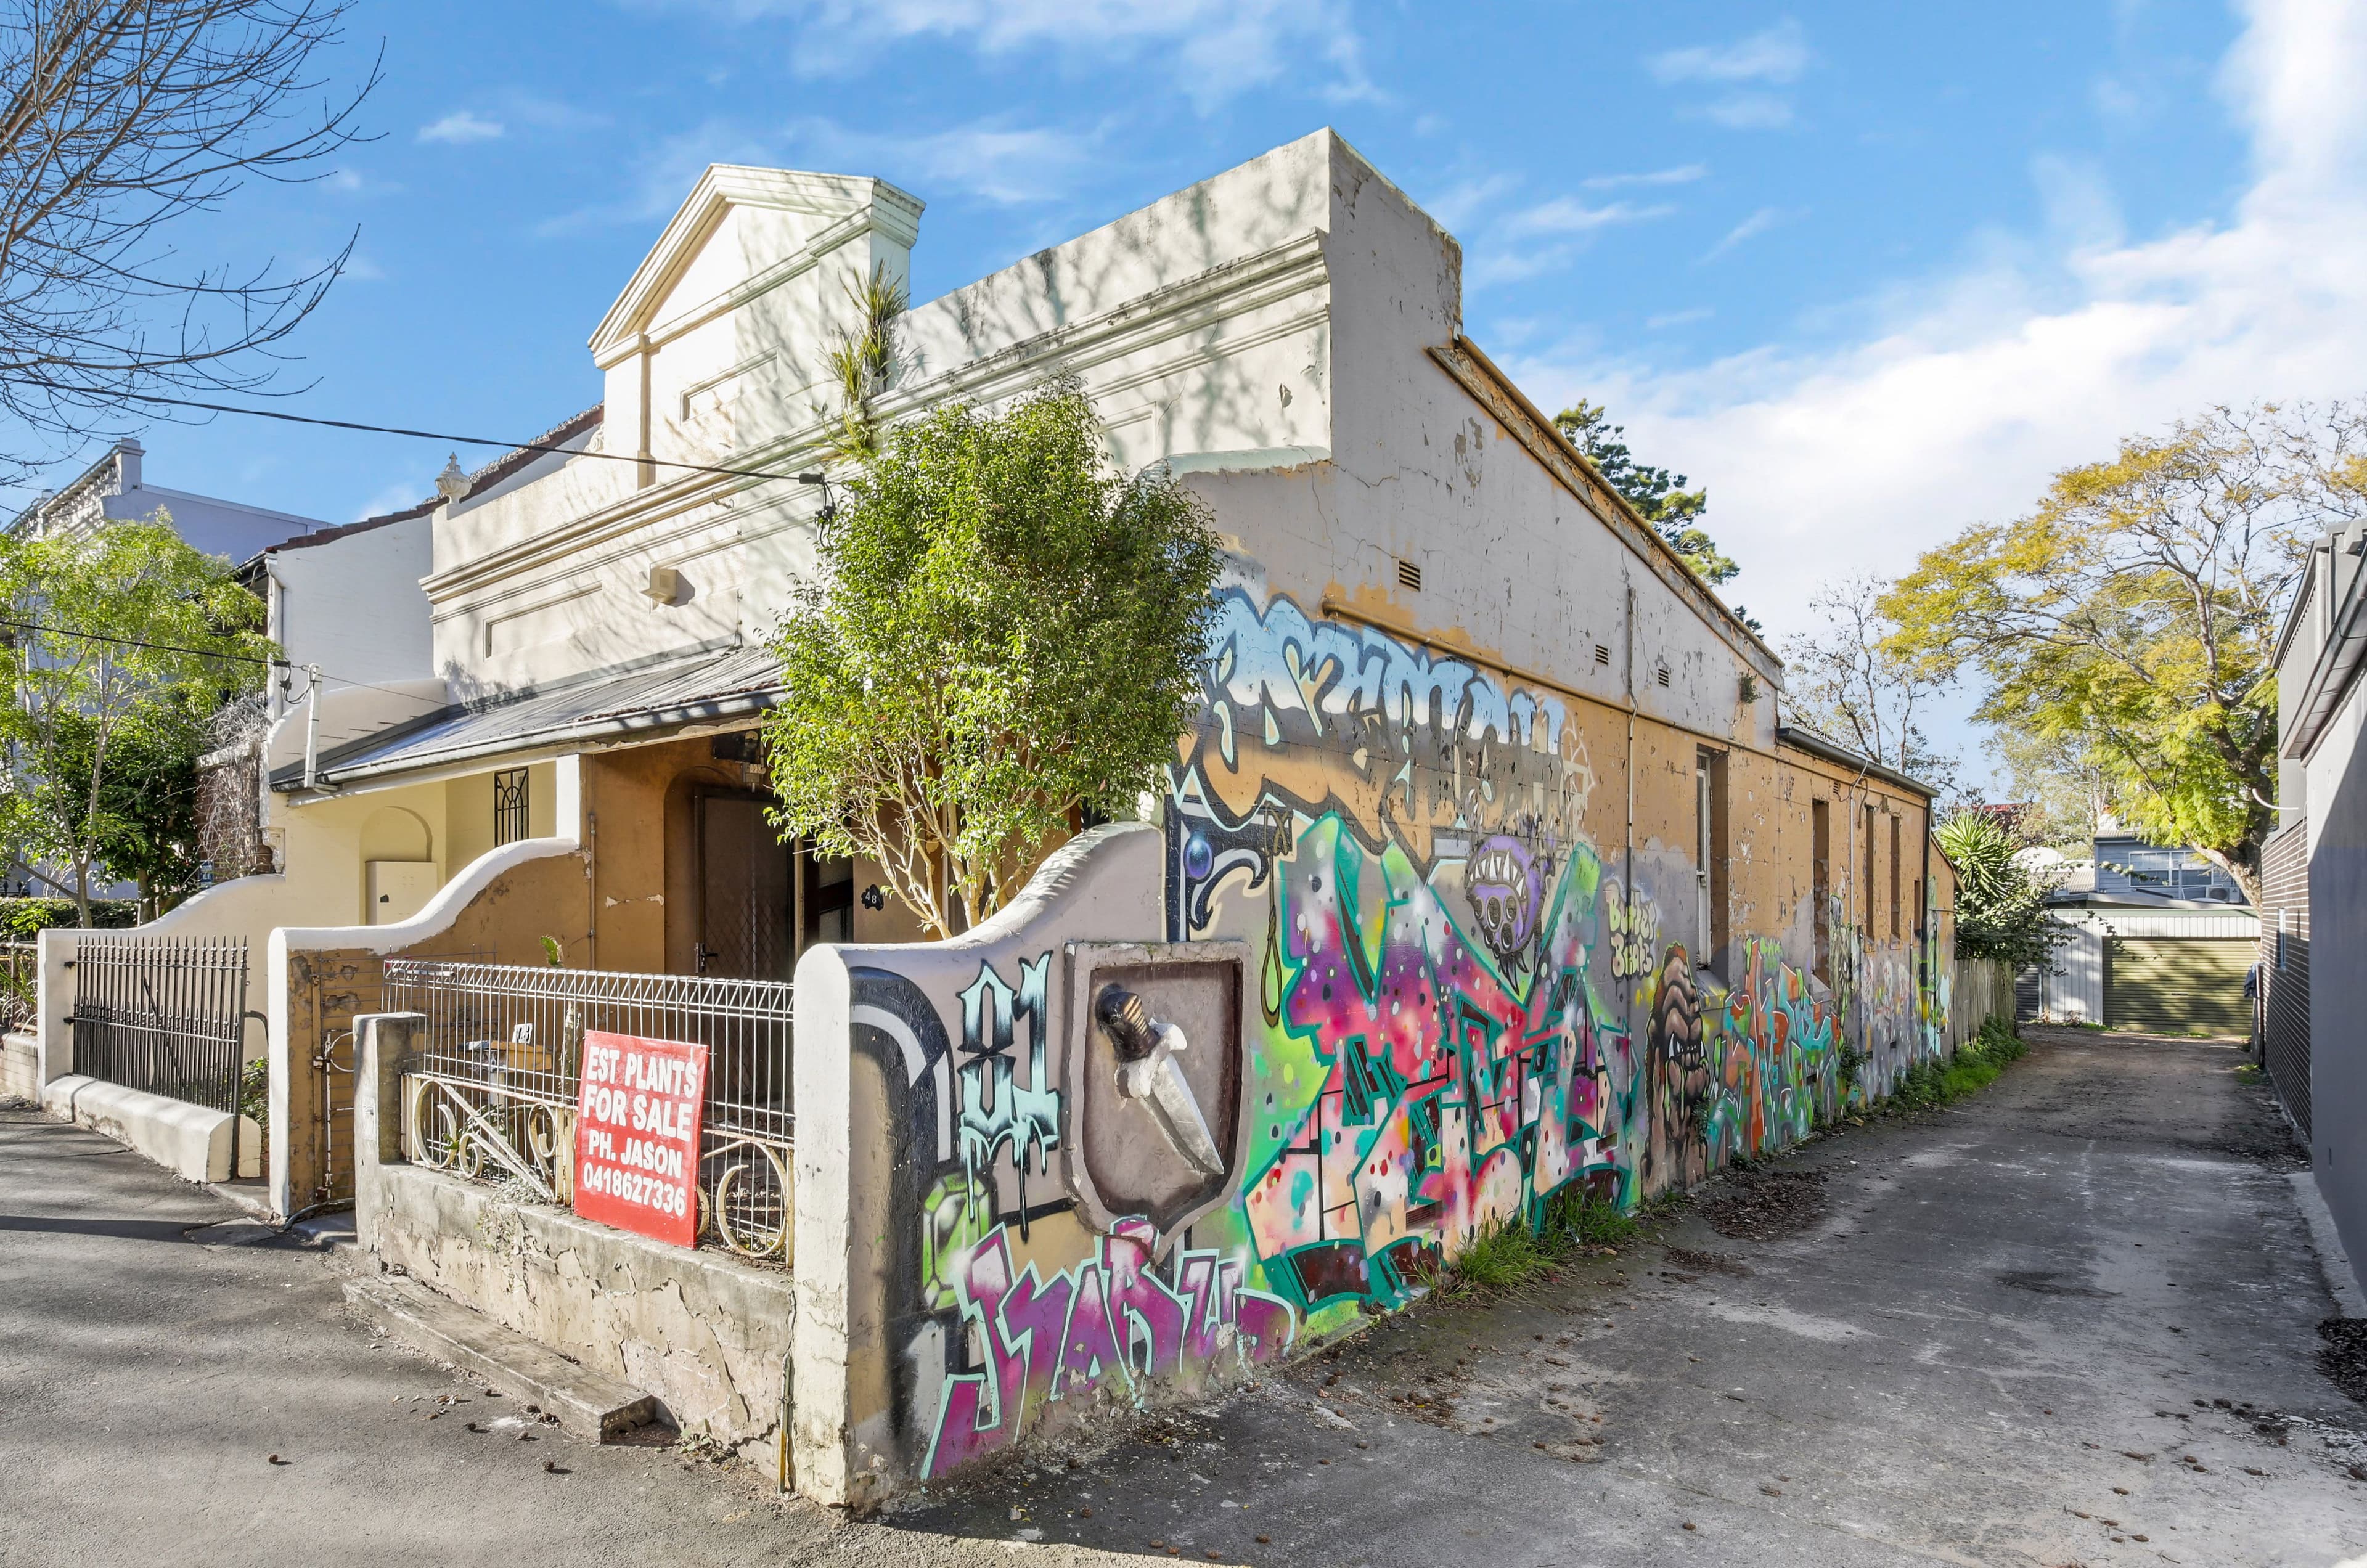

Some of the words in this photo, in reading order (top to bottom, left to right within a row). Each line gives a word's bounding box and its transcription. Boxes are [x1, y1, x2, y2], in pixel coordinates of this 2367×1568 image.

[865, 891, 877, 904] 48
[587, 1046, 621, 1084] EST
[624, 1053, 698, 1098] PLANTS
[583, 1084, 628, 1127] FOR
[632, 1094, 693, 1142] SALE
[589, 1130, 616, 1162] PH.
[620, 1137, 682, 1179] JASON
[584, 1162, 685, 1217] 0418627336
